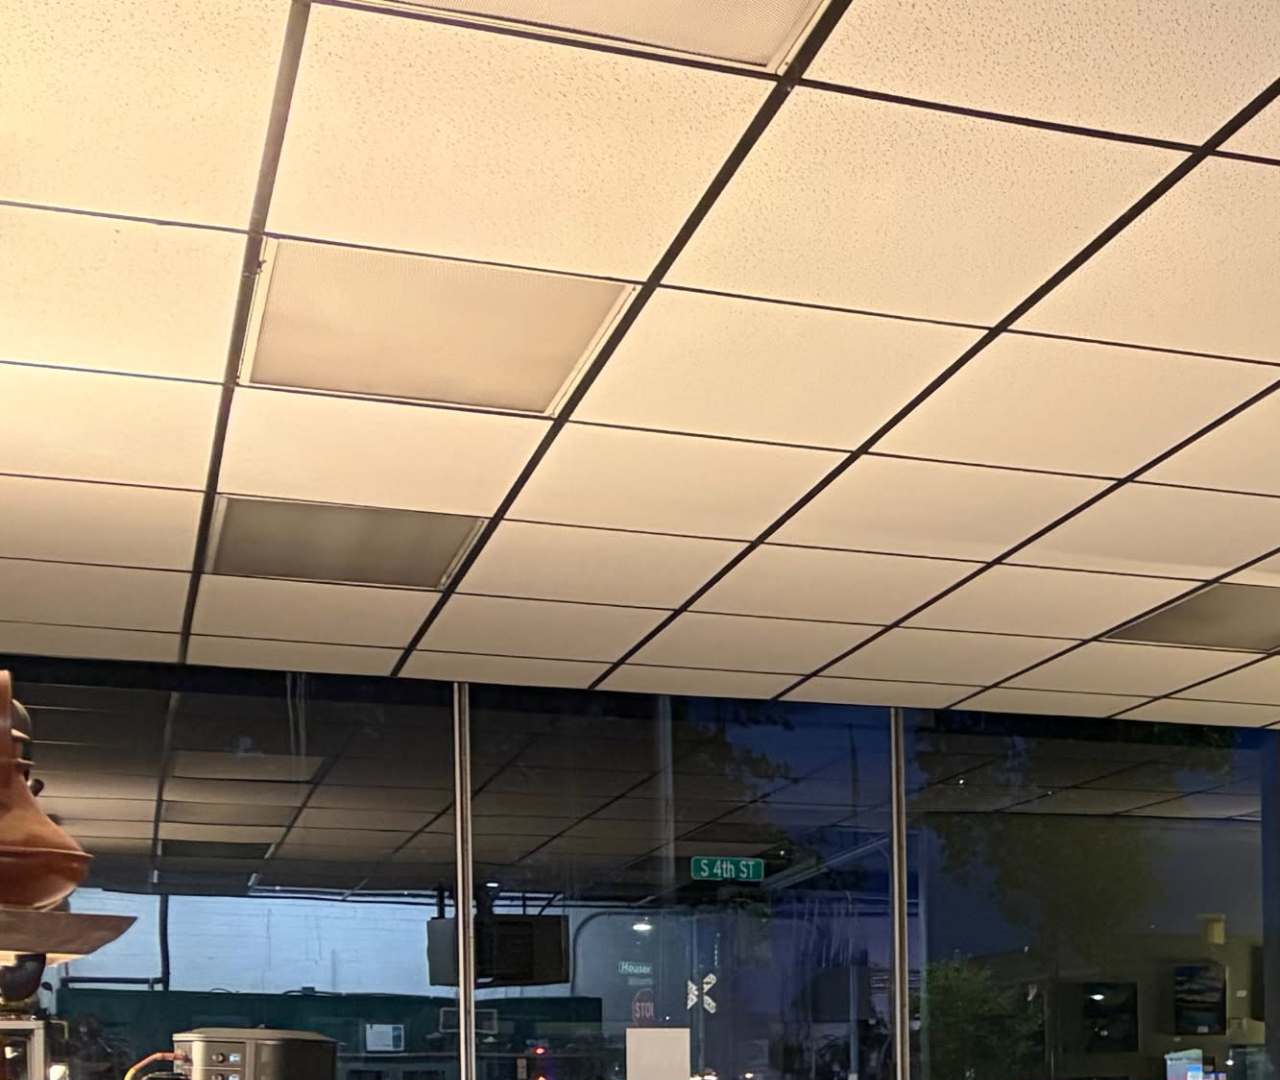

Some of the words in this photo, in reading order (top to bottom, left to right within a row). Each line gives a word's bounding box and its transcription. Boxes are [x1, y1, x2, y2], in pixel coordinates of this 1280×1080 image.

[701, 860, 709, 877] S
[713, 860, 735, 878] 4th
[739, 860, 755, 878] ST
